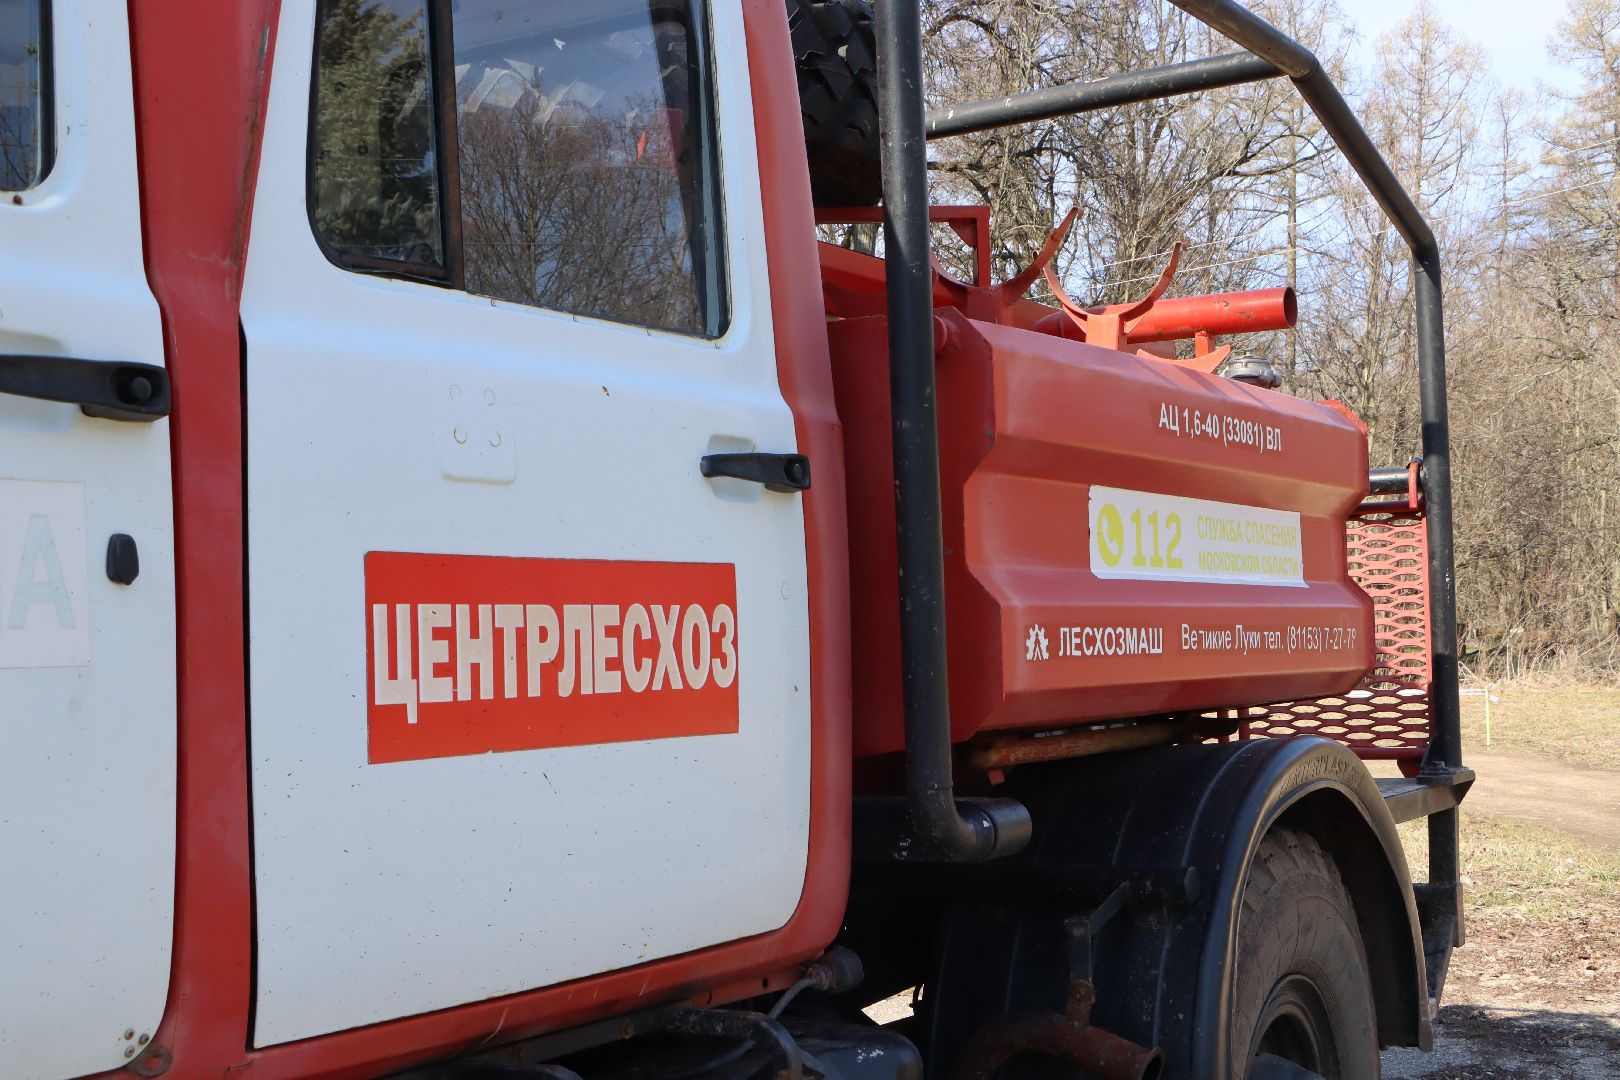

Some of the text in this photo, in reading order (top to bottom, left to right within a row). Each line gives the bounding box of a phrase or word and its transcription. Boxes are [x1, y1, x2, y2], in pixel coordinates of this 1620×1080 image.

[1158, 402, 1282, 453] АЦ 1,6-40 (33081) ВЛ
[1131, 508, 1183, 568] 112
[1197, 515, 1297, 548] СЛУЖБА СПАСЕНИЯ
[1198, 549, 1299, 577] МОСКОВСКОЙ ОБЛАСТИ
[1058, 627, 1163, 657] ЛЕСХОЗМАШ
[1235, 624, 1261, 656] Луки
[1263, 631, 1284, 650] тел.
[1287, 626, 1322, 654] (81153)
[372, 603, 737, 724] ЦЕНТРЛЕСХОЗ
